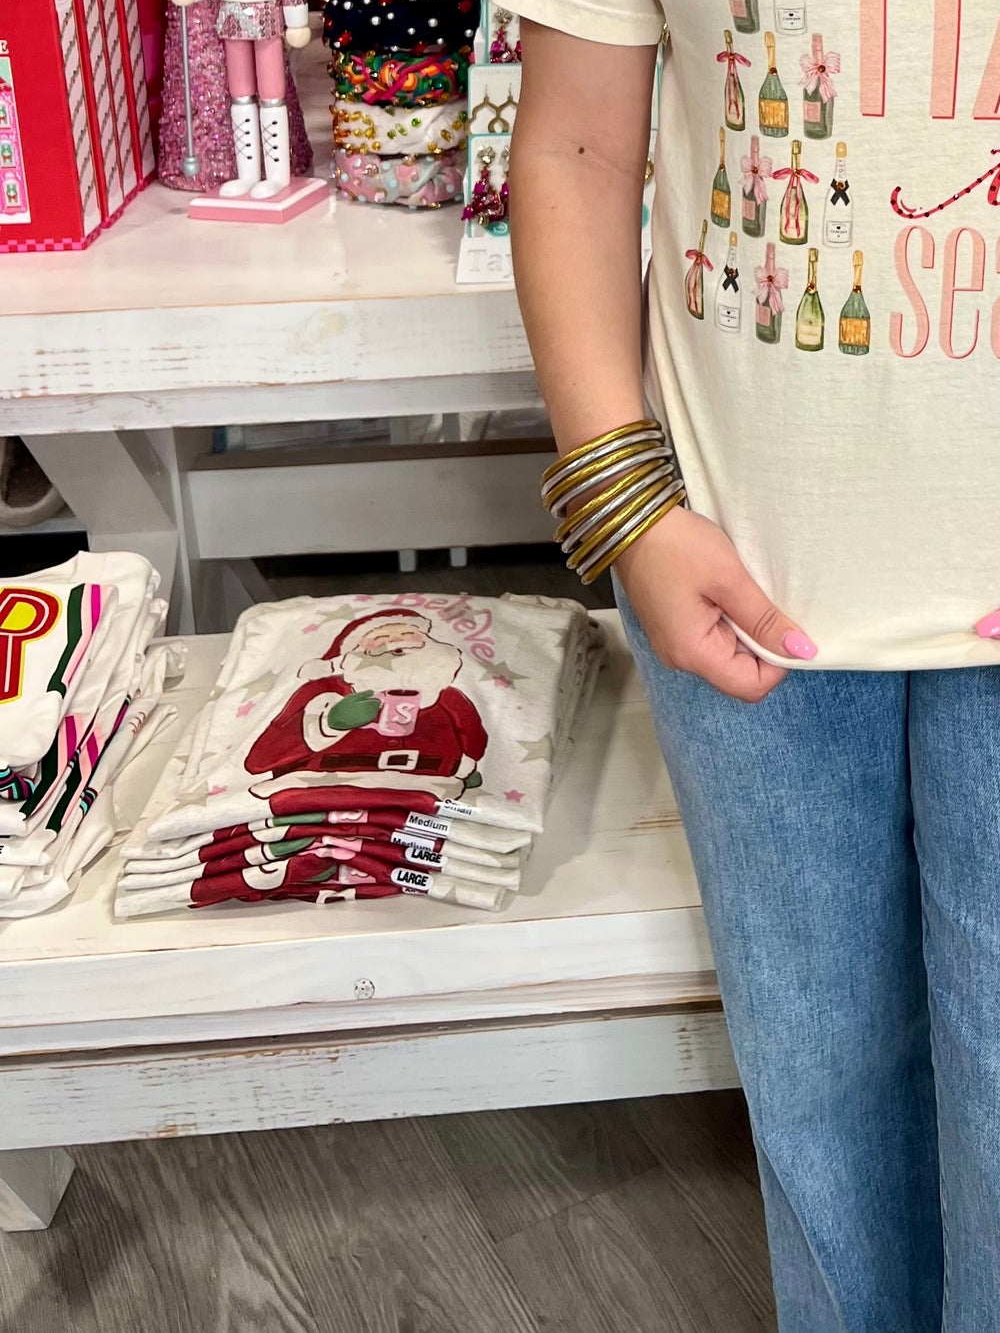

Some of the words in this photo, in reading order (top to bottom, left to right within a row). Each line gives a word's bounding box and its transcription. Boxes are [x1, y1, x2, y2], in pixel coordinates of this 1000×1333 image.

[408, 814, 449, 832] Medium
[411, 849, 443, 864] LARGE
[396, 869, 429, 887] LARGE
